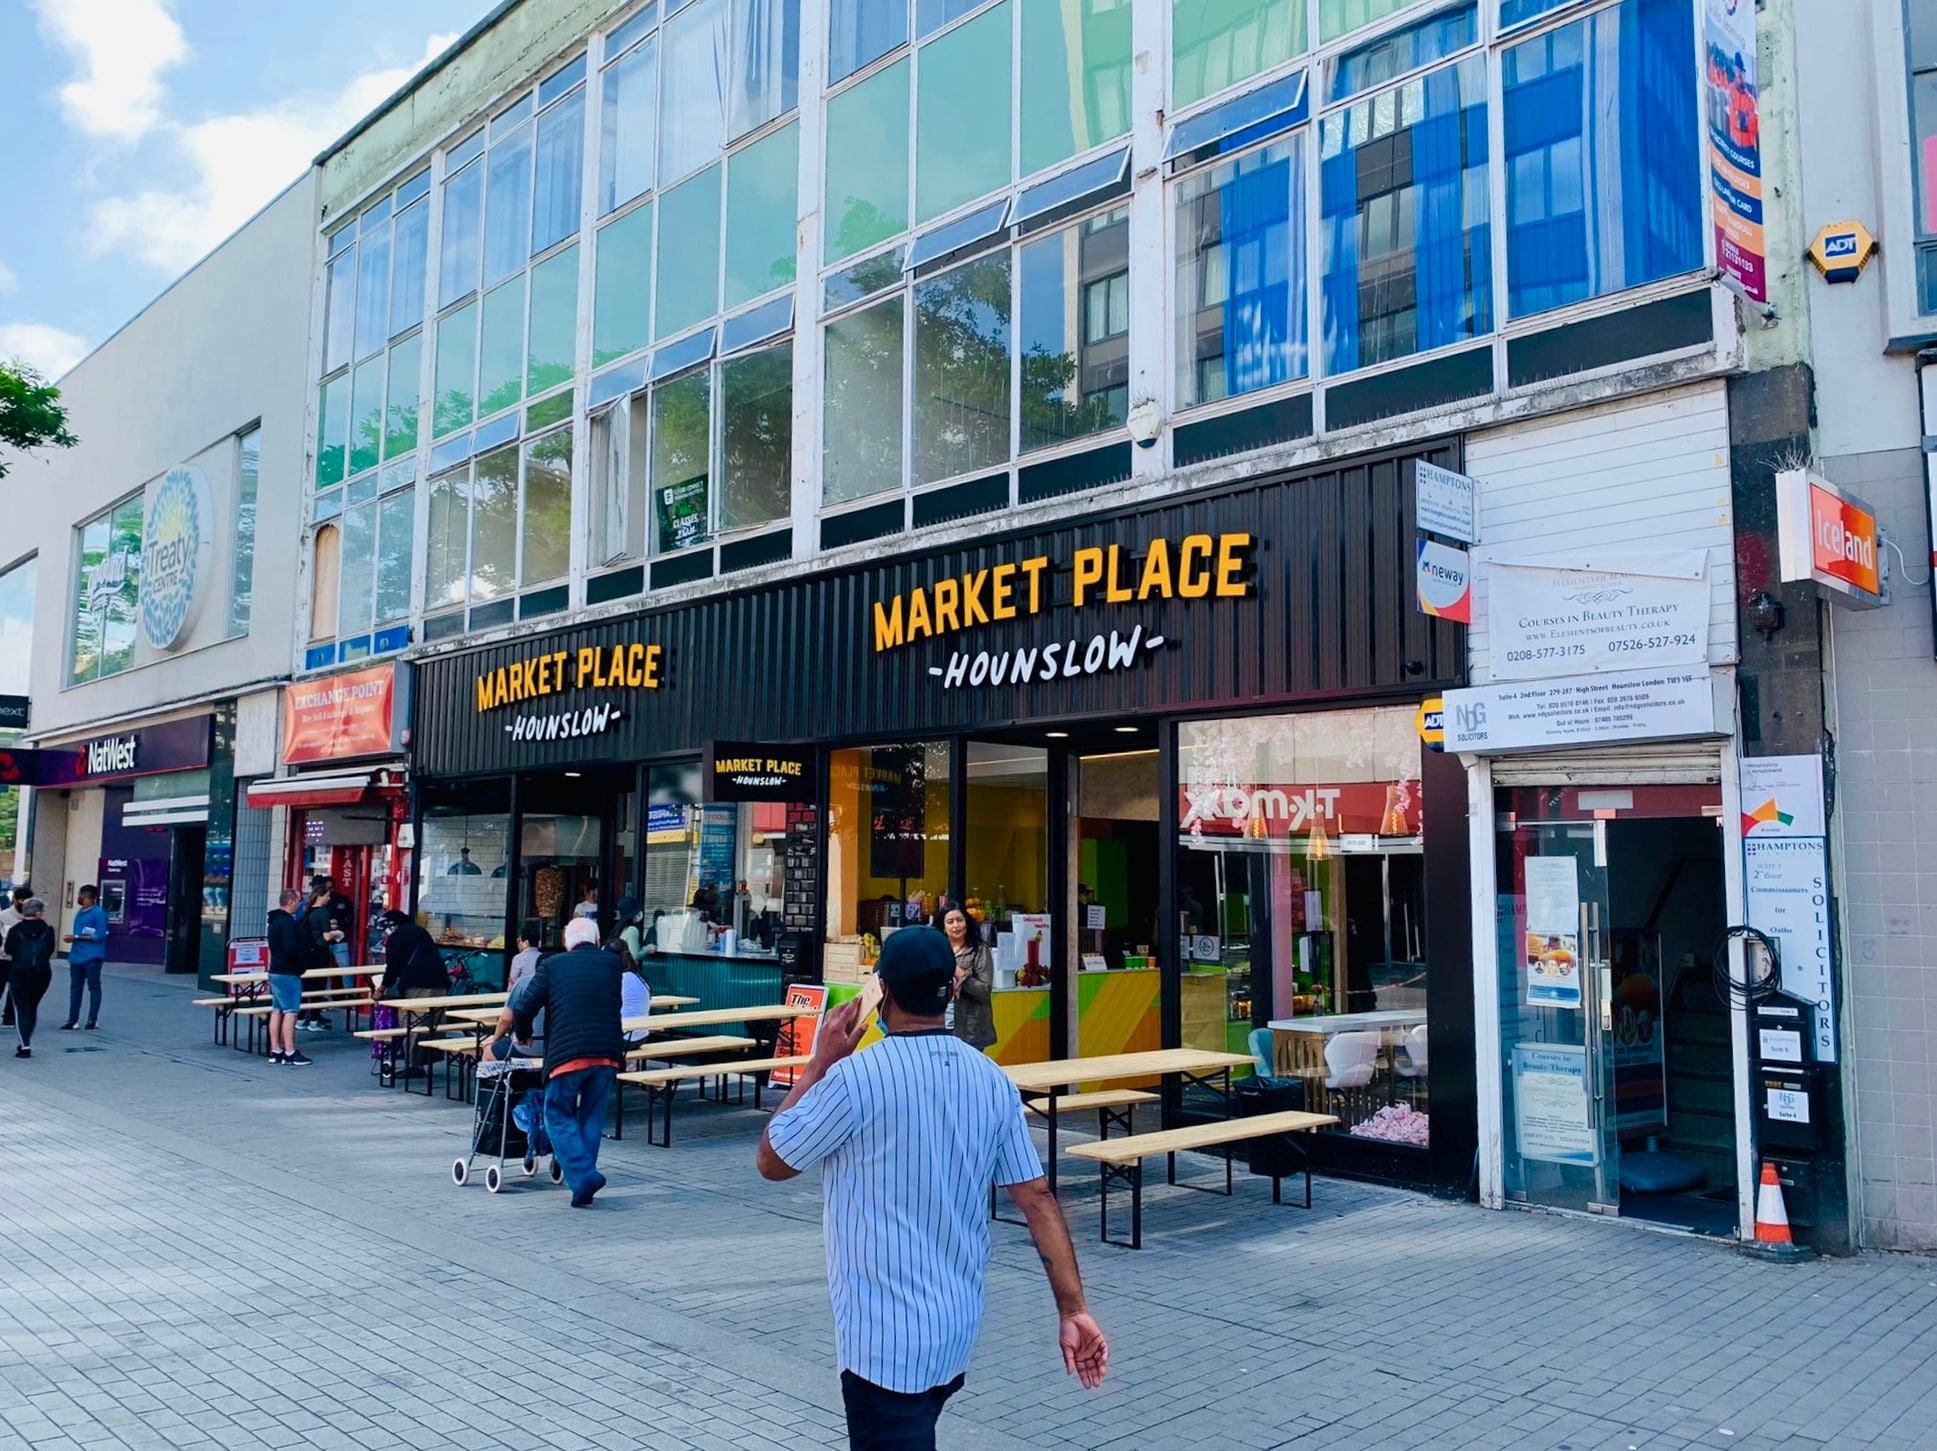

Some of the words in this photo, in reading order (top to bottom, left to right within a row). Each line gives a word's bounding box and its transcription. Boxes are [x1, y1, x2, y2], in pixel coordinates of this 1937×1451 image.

[1730, 149, 1755, 170] COURSES
[1826, 236, 1857, 252] ADT
[1426, 469, 1472, 493] HAMPTONS
[1817, 510, 1873, 570] Iceland
[148, 533, 191, 578] Treaty
[153, 570, 179, 594] CENTRE
[1431, 564, 1464, 586] neway
[874, 556, 1048, 652] MARKET
[1073, 533, 1250, 607] PLACE
[1507, 644, 1586, 662] 0208-577-3175
[1608, 634, 1696, 653] 07526-527-924
[478, 651, 568, 713] MARKET
[577, 643, 662, 689] PLACE
[1590, 683, 1608, 692] Street
[1641, 679, 1665, 687] London
[295, 687, 350, 710] EXCHANGE
[351, 680, 385, 700] POINT
[1457, 732, 1489, 742] SOLICITORS
[88, 734, 136, 774] NatWest
[715, 759, 763, 773] MARKET
[766, 760, 802, 776] PLACE
[1757, 842, 1823, 851] HAMPTONS
[1812, 876, 1831, 1047] SOLICITORS
[791, 993, 811, 1006] The
